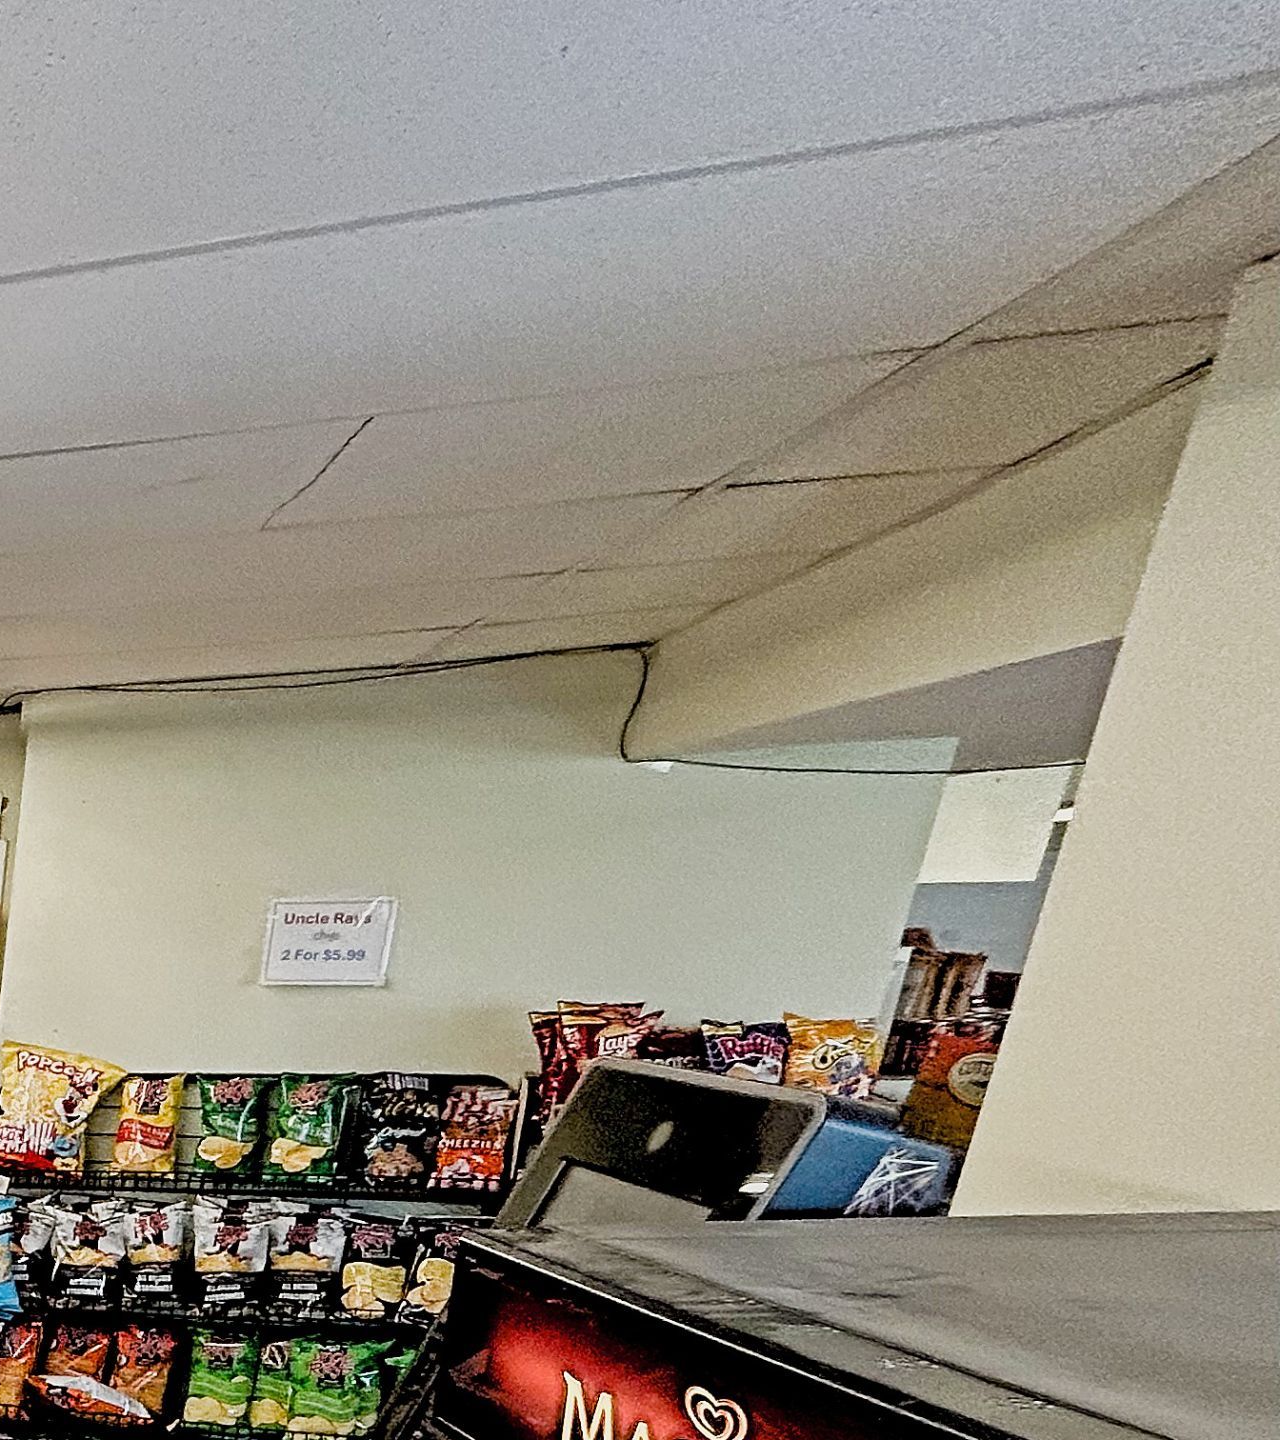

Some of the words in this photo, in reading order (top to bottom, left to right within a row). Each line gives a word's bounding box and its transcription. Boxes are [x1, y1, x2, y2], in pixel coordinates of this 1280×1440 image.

[284, 912, 330, 925] Uncle
[333, 911, 373, 928] Rays
[280, 949, 291, 961] 2
[294, 948, 320, 961] For
[321, 947, 367, 962] $5.99
[16, 1049, 104, 1087] POPCORN
